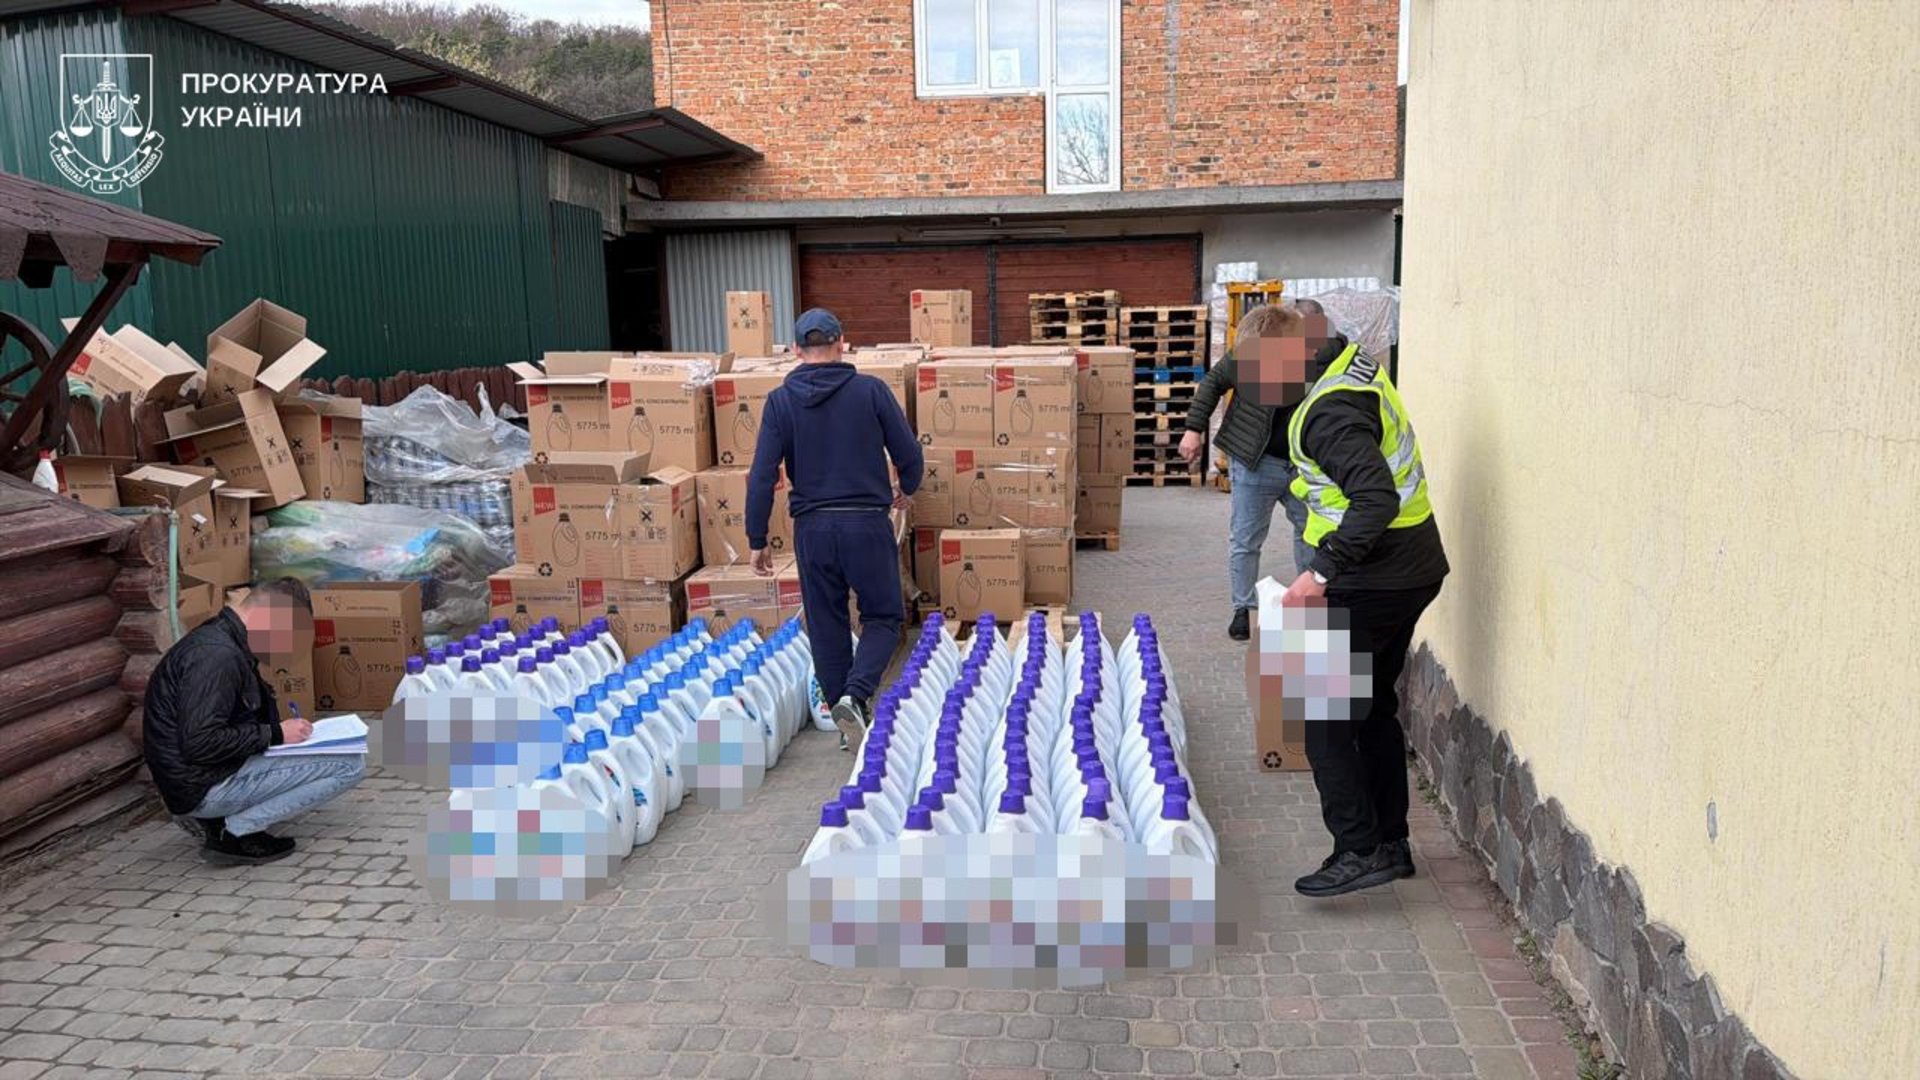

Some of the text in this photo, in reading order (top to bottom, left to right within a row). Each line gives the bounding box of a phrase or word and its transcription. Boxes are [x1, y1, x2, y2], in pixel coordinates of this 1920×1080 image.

[611, 396, 631, 405] NEW
[960, 404, 981, 414] 5775
[1038, 404, 1059, 413] 5775
[576, 421, 598, 431] 5775
[659, 425, 695, 435] 5775 ml
[997, 486, 1017, 495] 5775
[534, 502, 555, 511] NEW
[585, 531, 608, 541] 5775
[943, 554, 961, 563] NEW
[1036, 565, 1056, 574] 5775
[986, 578, 1008, 588] 5775
[633, 623, 671, 633] 5775 ml
[366, 663, 392, 673] 5775
